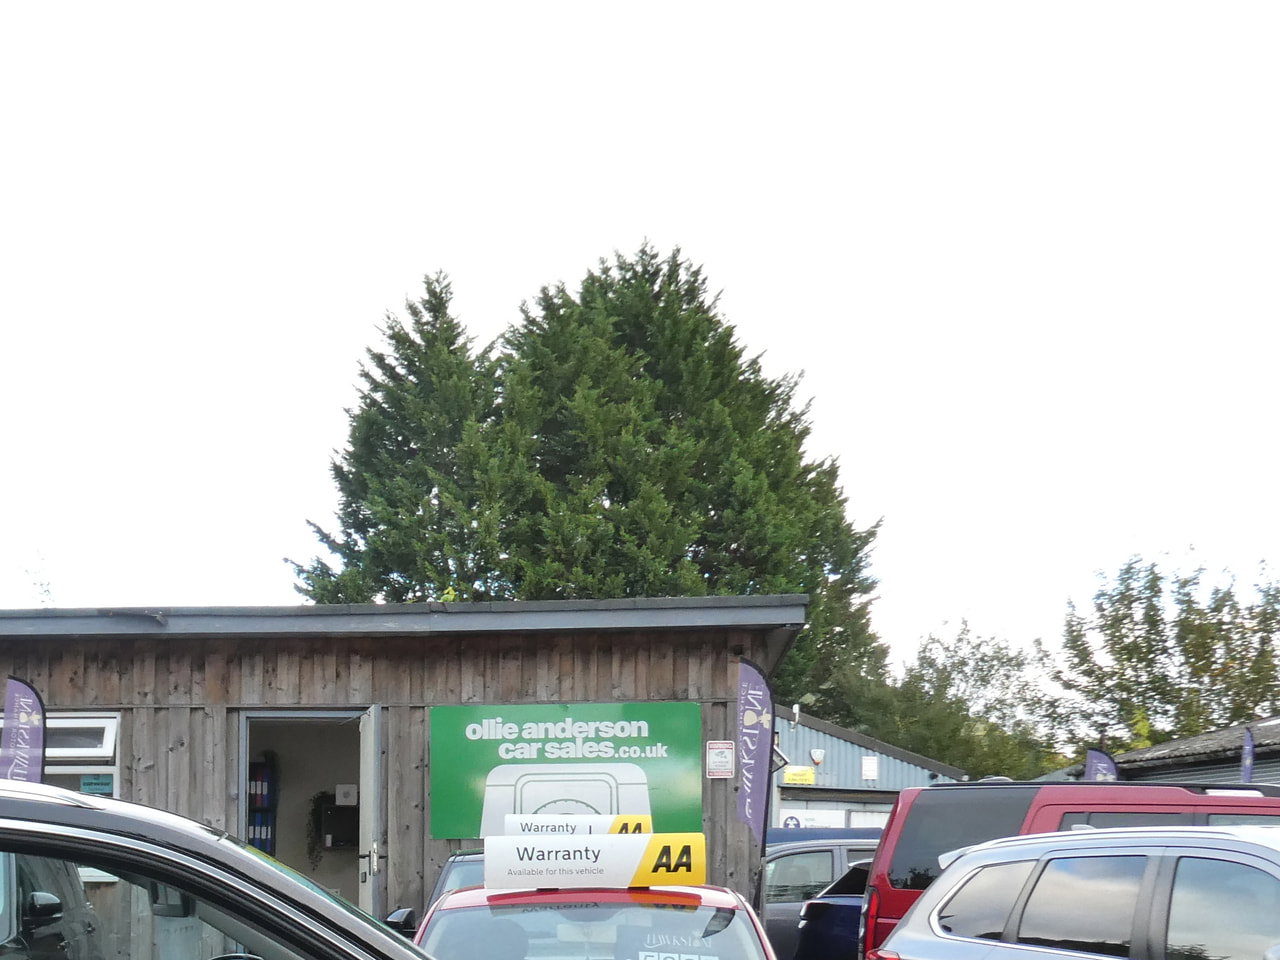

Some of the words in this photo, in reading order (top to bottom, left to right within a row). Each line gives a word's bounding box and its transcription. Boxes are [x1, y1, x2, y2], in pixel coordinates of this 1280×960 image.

[465, 717, 519, 740] ollie
[521, 717, 649, 739] anderson
[498, 741, 542, 759] car
[544, 737, 668, 759] sales.co.uk
[520, 822, 577, 835] Warranty
[516, 846, 601, 863] Warranty
[651, 845, 692, 872] AA
[507, 868, 543, 876] Available
[545, 868, 557, 876] for
[558, 868, 574, 876] this
[575, 867, 604, 875] vehicle
